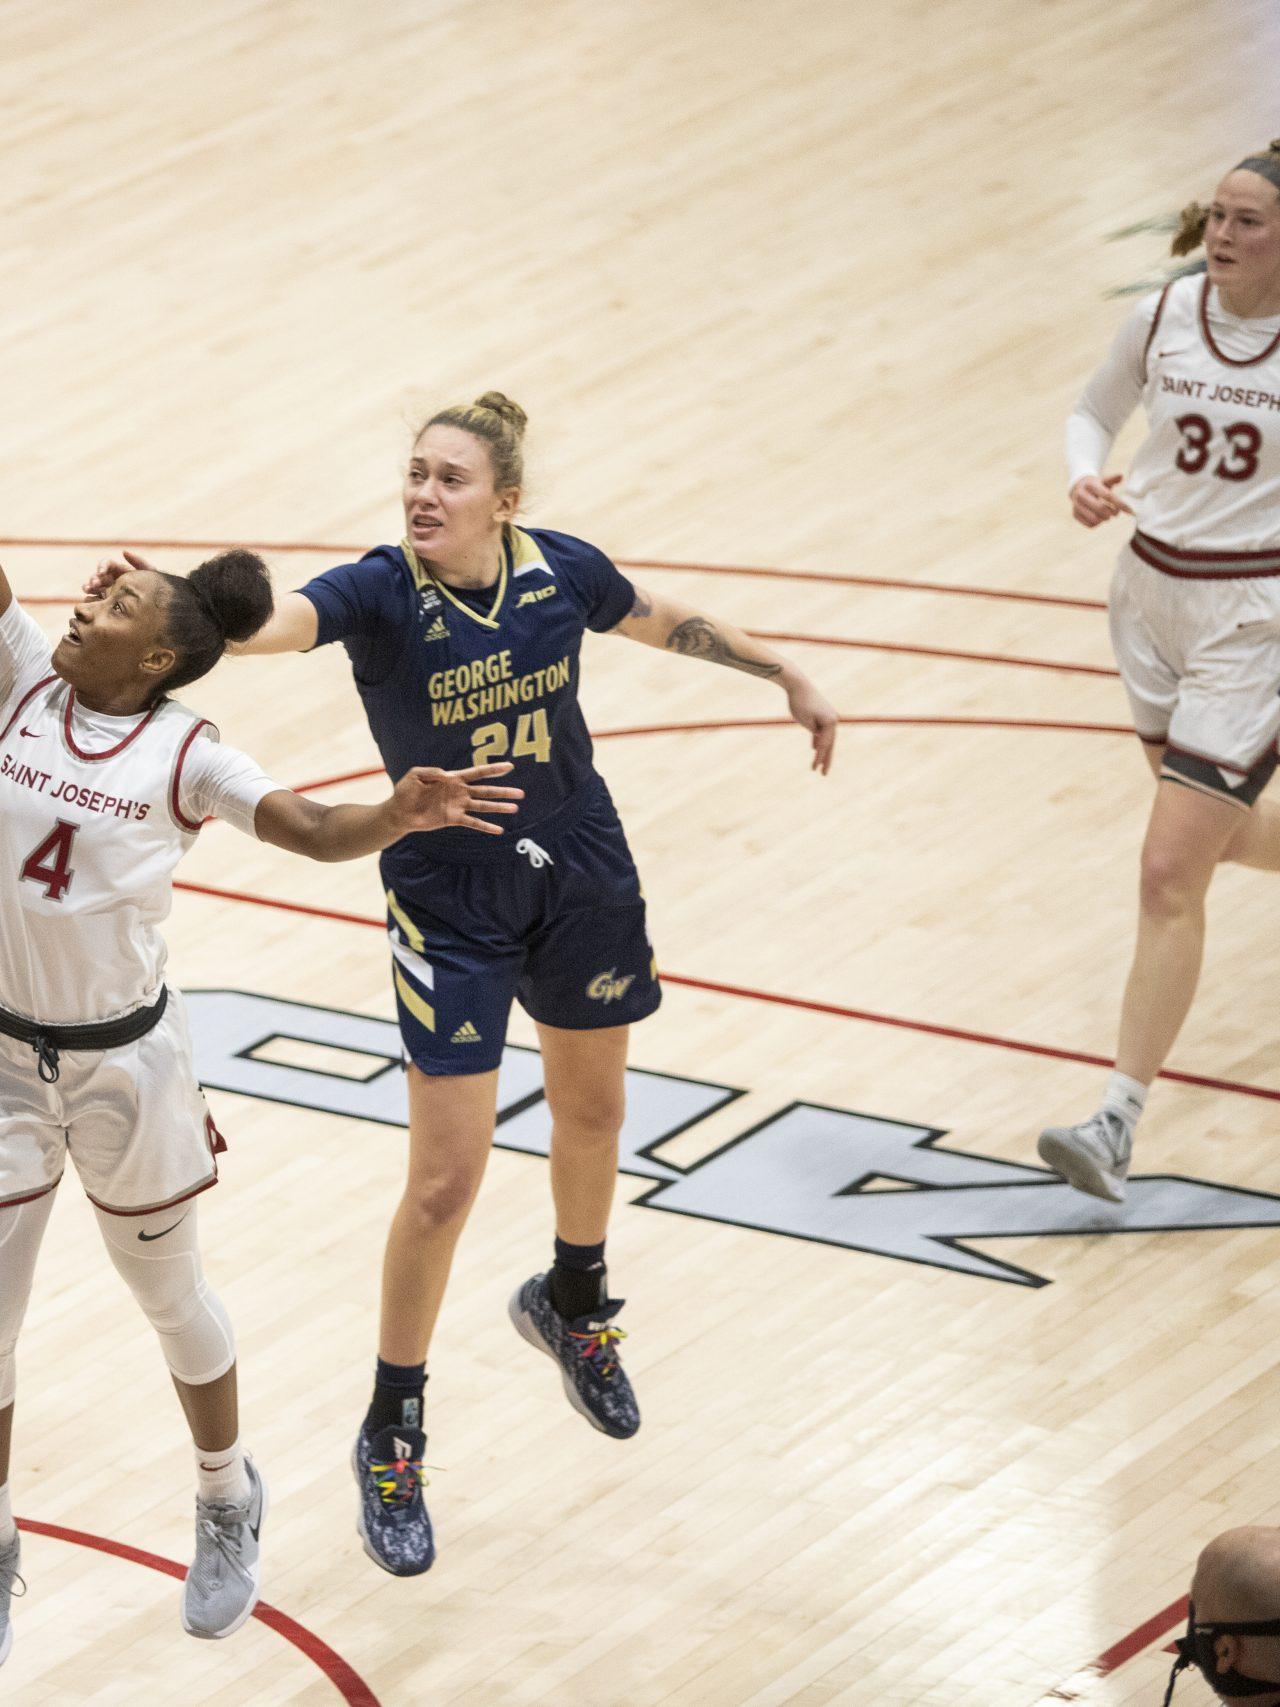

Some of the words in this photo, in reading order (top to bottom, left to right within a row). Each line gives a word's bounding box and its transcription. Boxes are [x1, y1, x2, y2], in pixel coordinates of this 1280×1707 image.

[1175, 412, 1263, 483] 33
[428, 649, 514, 701] GEORGE
[430, 655, 570, 727] WASHINGTON
[470, 707, 552, 768] 24
[0, 753, 52, 793] SAINT
[50, 780, 152, 822] JOSEPH'S
[18, 816, 81, 903] 4
